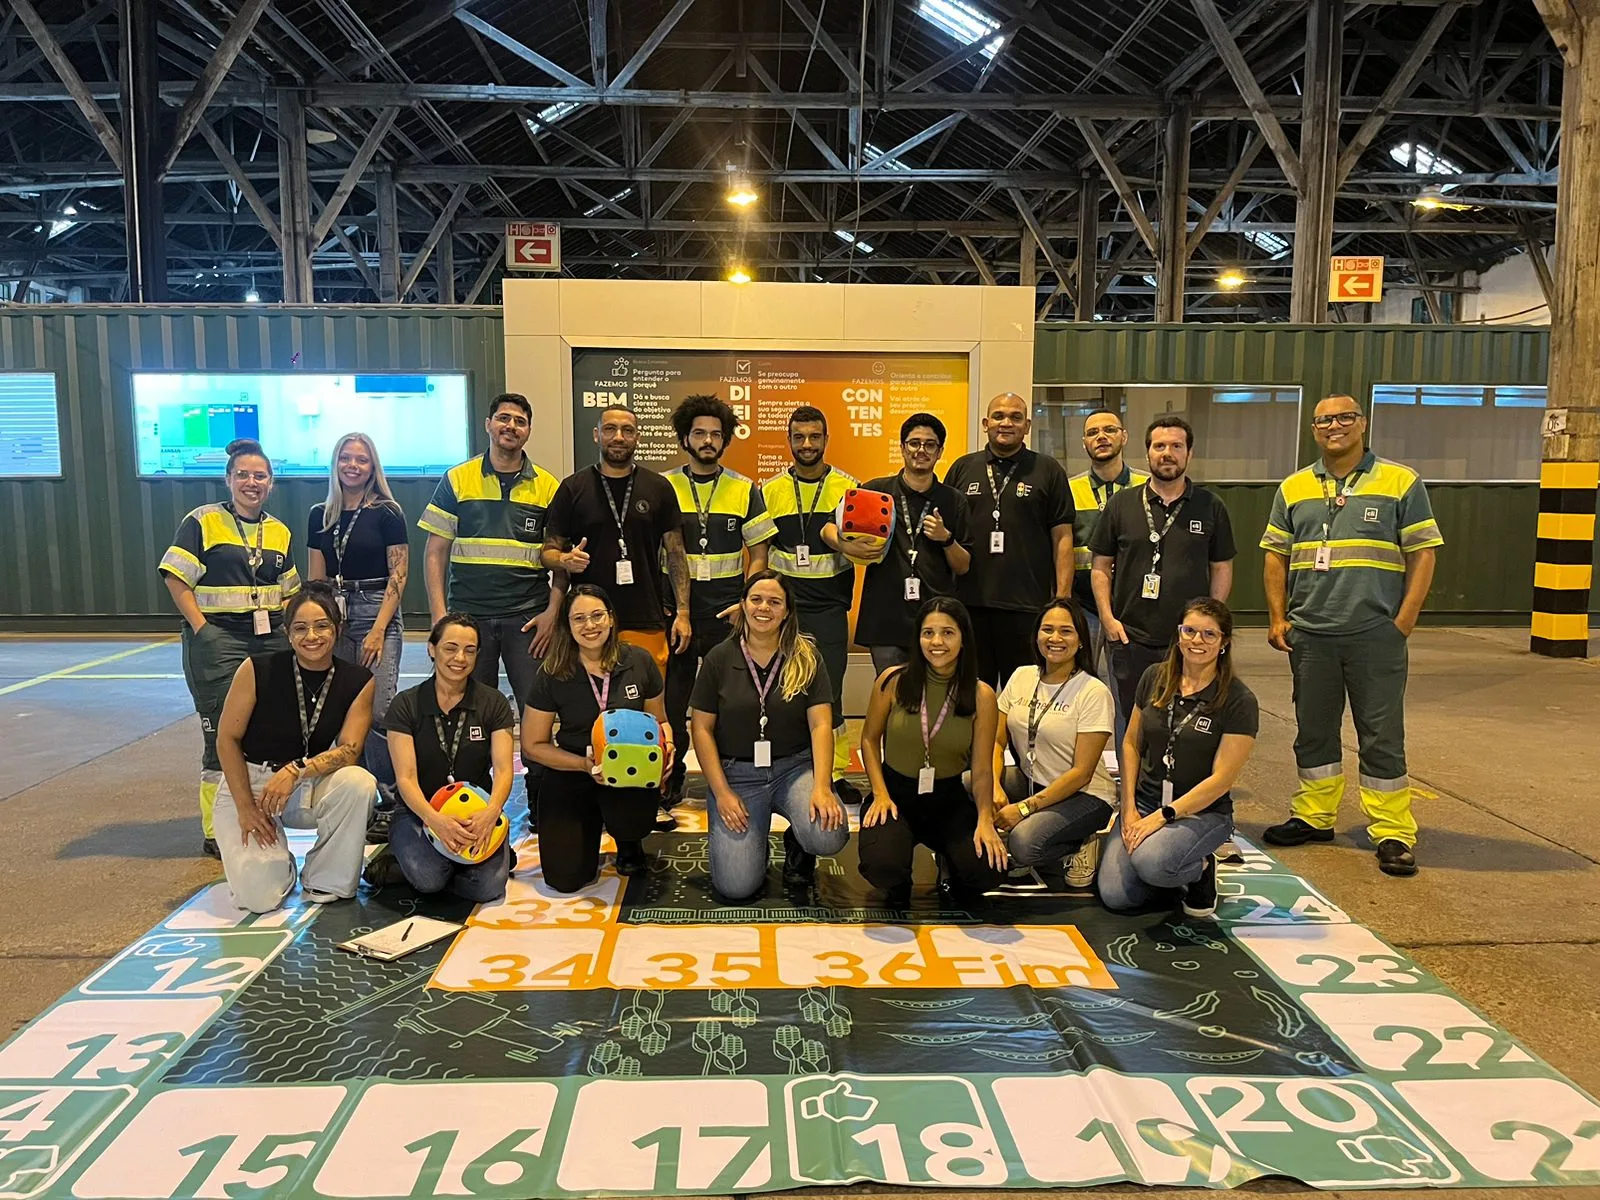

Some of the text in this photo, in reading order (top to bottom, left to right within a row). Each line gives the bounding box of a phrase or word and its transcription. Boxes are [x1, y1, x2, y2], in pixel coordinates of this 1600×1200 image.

[583, 392, 628, 408] BEM
[730, 385, 750, 401] DI
[842, 388, 882, 403] CON
[732, 405, 750, 420] EI
[847, 406, 882, 420] TEN
[734, 424, 751, 440] O
[850, 423, 882, 437] TES
[497, 897, 607, 925] 33
[1223, 895, 1348, 922] 24
[147, 957, 263, 992] 12
[468, 953, 594, 987] 34
[642, 952, 762, 987] 35
[813, 951, 927, 985] 36
[946, 954, 1093, 986] Fim
[1296, 954, 1424, 988] 23
[54, 1033, 187, 1081] 13
[1373, 1025, 1512, 1072] 22
[1196, 1079, 1377, 1132] 20
[168, 1131, 323, 1198] 15
[404, 1128, 541, 1196] 16
[631, 1125, 770, 1190] 17
[851, 1122, 1002, 1184] 18
[1075, 1117, 1240, 1188] 19
